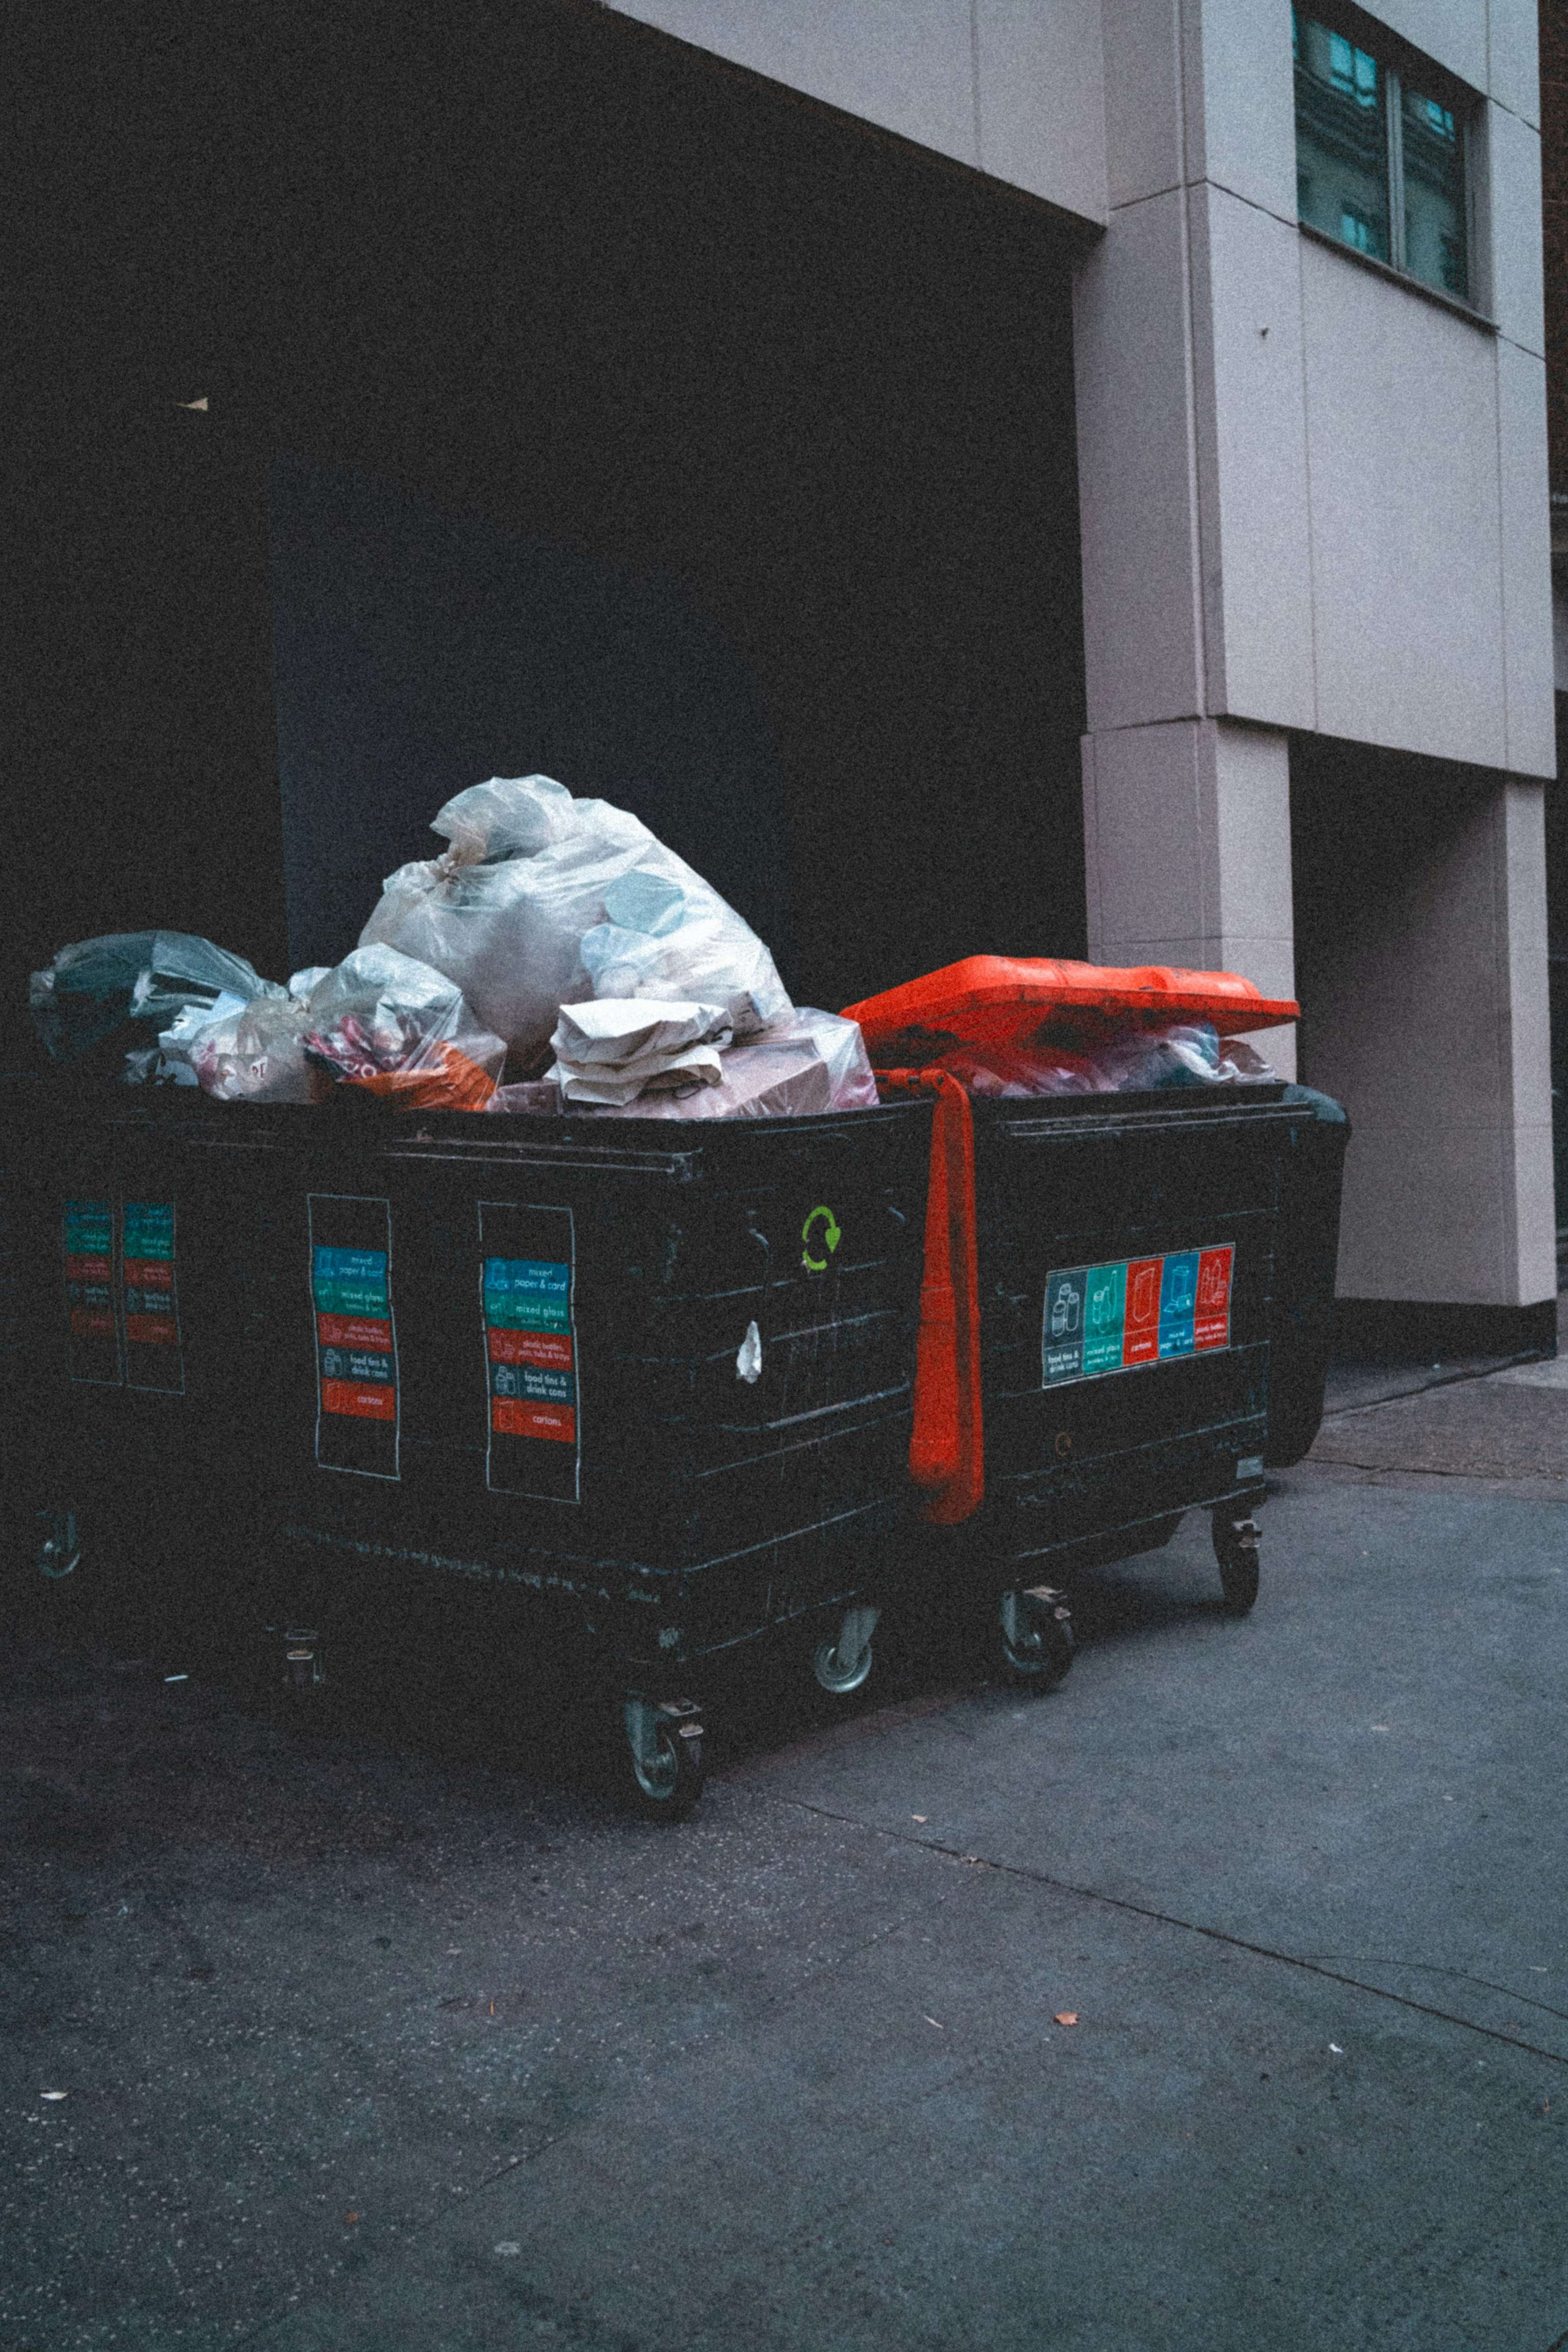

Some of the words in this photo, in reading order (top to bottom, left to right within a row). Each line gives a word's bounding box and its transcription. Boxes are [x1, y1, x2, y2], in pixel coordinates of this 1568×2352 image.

[529, 1267, 553, 1277] mixed
[514, 1279, 538, 1289] paper
[540, 1279, 545, 1289] &
[547, 1281, 566, 1291] card
[516, 1303, 541, 1314] mixed
[543, 1306, 564, 1317] glass
[524, 1371, 543, 1383] food
[545, 1374, 558, 1385] tins
[560, 1377, 567, 1386] &
[527, 1383, 547, 1394] drink
[549, 1389, 566, 1398] cans
[357, 1396, 382, 1405] cartons
[533, 1415, 561, 1426] cartons
